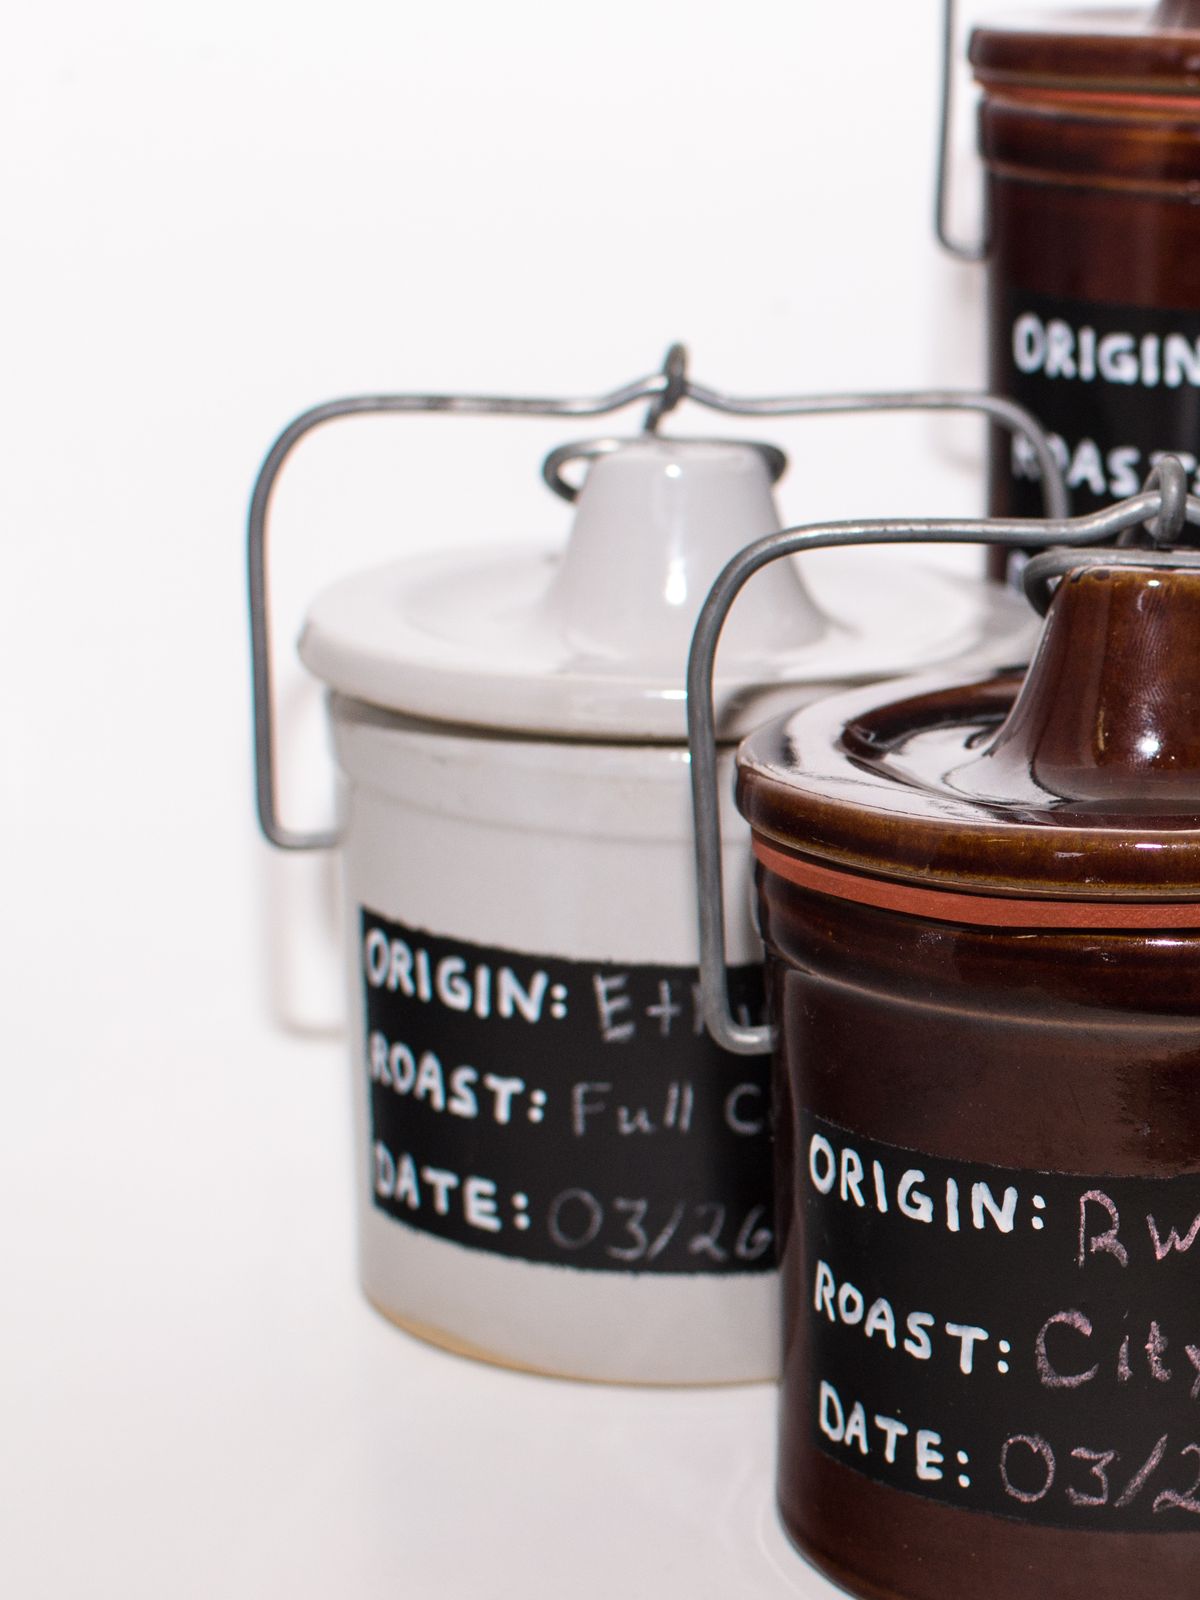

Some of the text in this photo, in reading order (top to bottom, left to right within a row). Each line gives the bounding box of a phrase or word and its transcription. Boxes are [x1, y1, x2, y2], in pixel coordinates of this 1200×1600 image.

[366, 928, 568, 1024] ORIGIN:
[370, 1030, 548, 1126] ROAST:
[572, 1082, 695, 1137] Full
[374, 1141, 772, 1262] DATE: 03/26
[809, 1134, 1047, 1235] ORIGIN:
[815, 1260, 1011, 1375] ROAST:
[819, 1381, 971, 1489] DATE:
